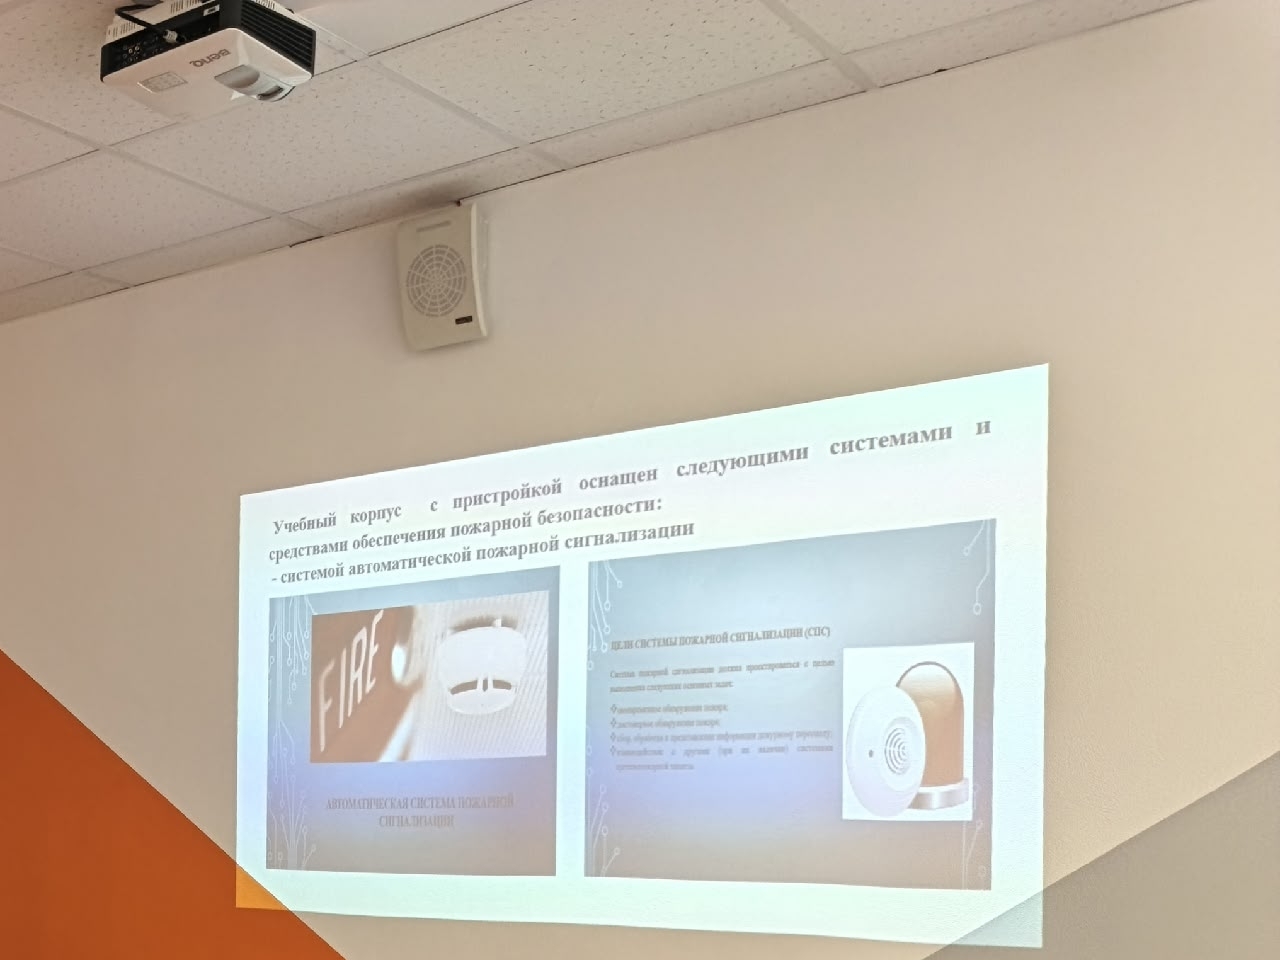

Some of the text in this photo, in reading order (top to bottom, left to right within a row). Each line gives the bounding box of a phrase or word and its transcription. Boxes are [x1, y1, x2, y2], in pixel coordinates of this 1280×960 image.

[273, 420, 991, 535] Учебный корпус с пристройкой оснащен следующими системами и
[269, 497, 662, 562] средствами обеспечения пожарной безопасности:
[280, 562, 344, 585] системой
[348, 547, 471, 576] автоматической
[476, 535, 559, 562] пожарной
[565, 521, 694, 550] сигнализации
[634, 635, 678, 649] СИСТЕМЫ
[679, 630, 728, 646] ПОЖАРНОЙ
[729, 628, 803, 643] СИГНАЛИЗАЦИИ
[319, 609, 384, 752] FIRE
[326, 797, 408, 810] АВТОМАТИЧЕСКАЯ
[410, 797, 456, 810] СИСТЕМА
